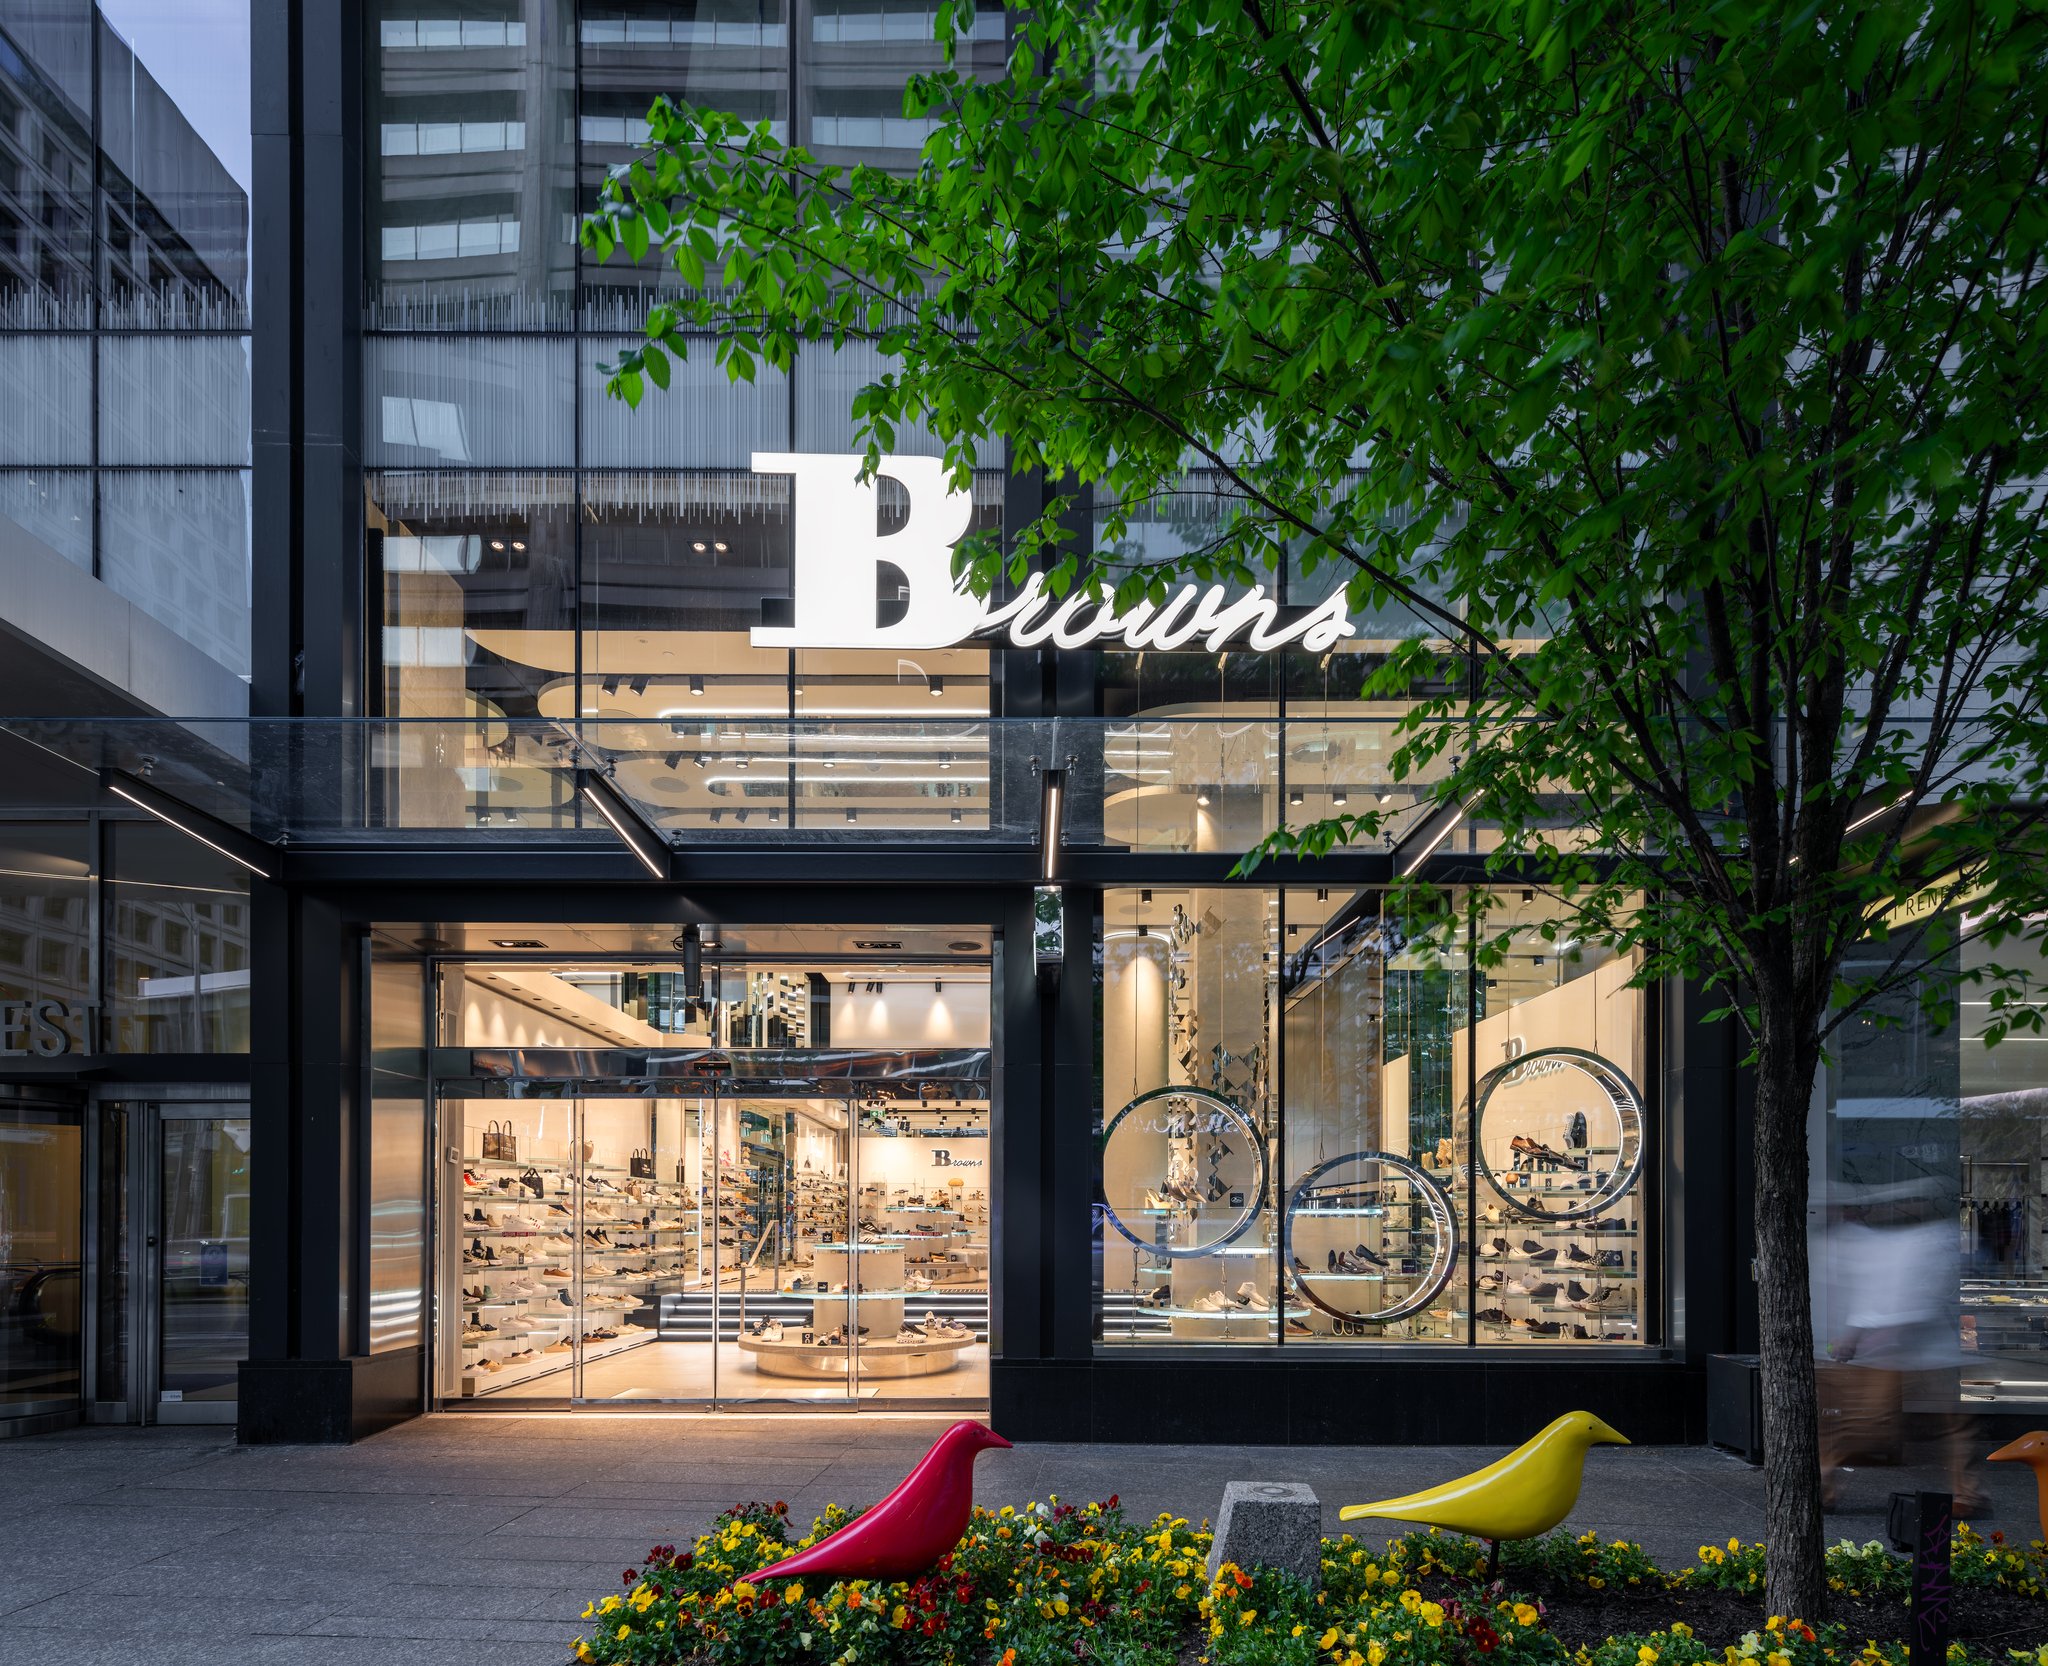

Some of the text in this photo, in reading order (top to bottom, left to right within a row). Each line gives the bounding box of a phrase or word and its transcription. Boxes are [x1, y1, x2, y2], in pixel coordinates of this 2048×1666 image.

[750, 452, 1356, 652] Browns
[1906, 873, 1988, 916] RENF
[0, 999, 102, 1057] EST
[1500, 1036, 1563, 1085] Brow
[931, 1149, 983, 1167] Browns
